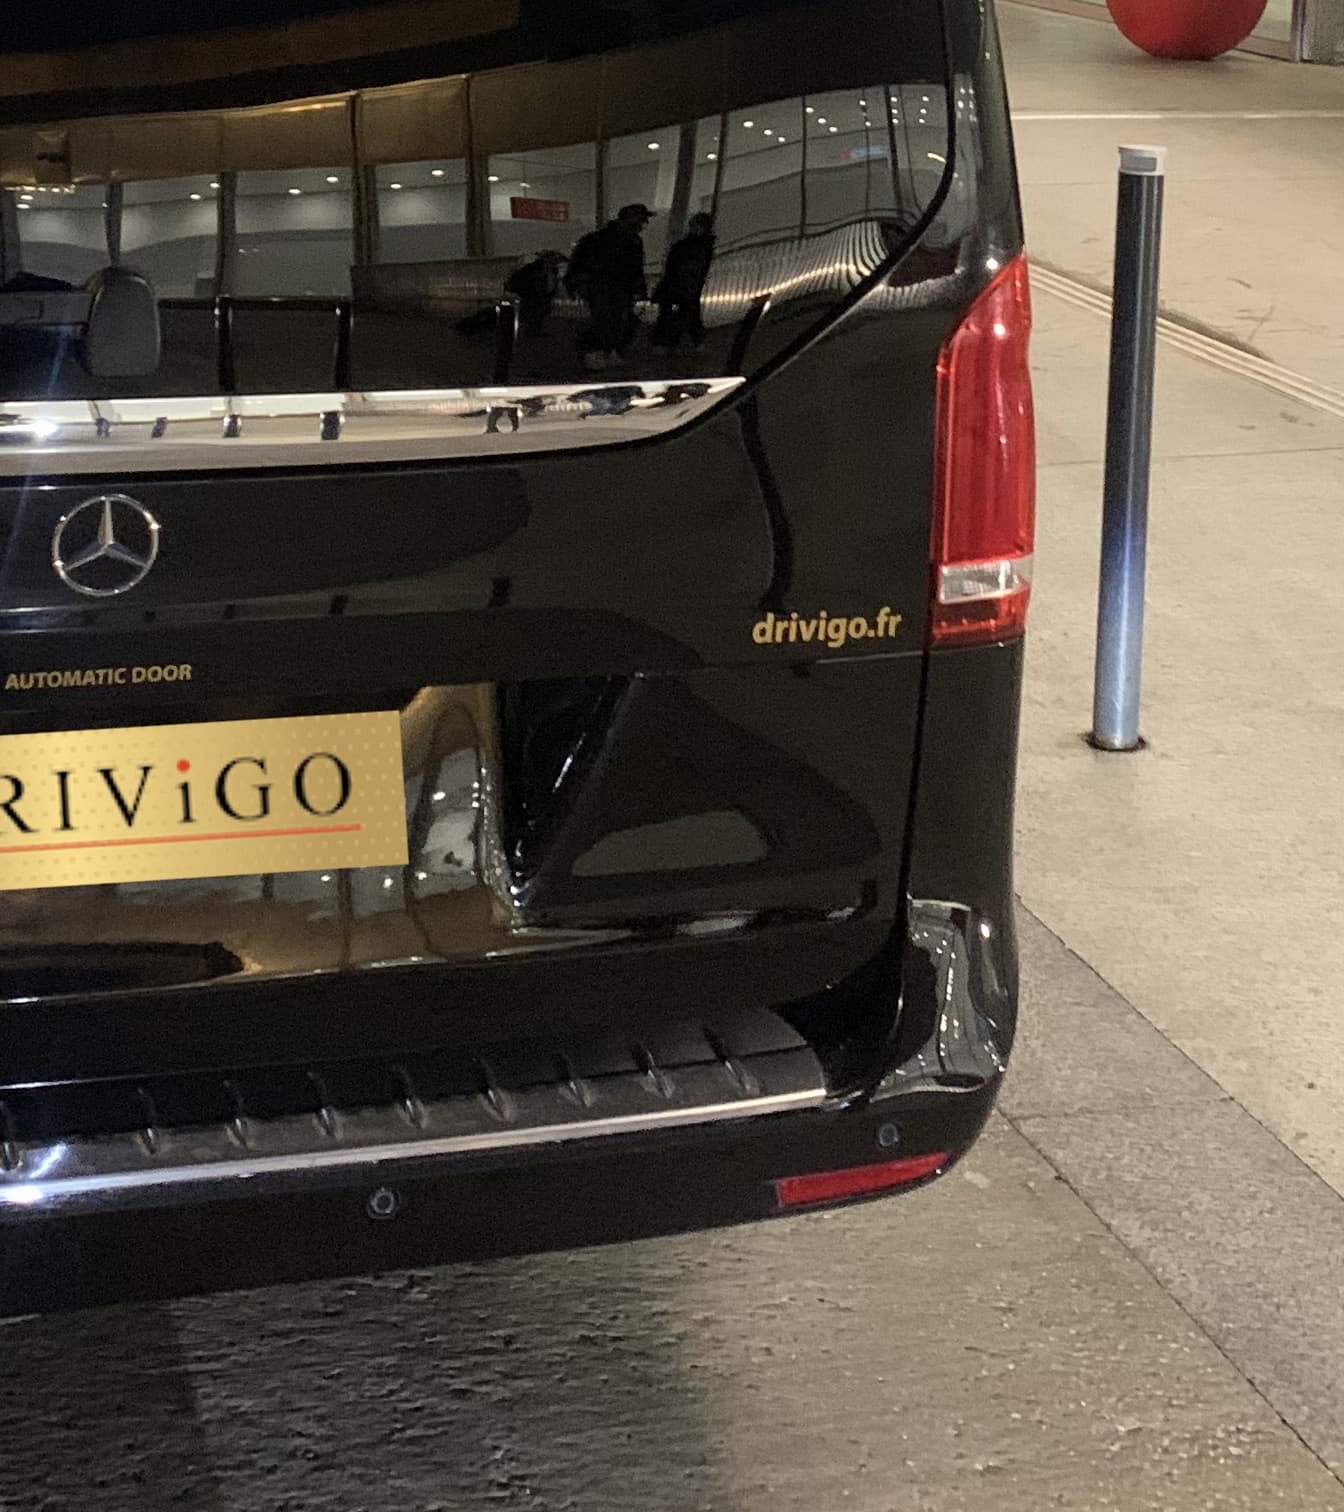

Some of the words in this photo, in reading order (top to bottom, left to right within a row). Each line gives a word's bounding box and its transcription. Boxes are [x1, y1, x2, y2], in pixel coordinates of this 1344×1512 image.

[751, 605, 903, 648] drivigo.fr
[4, 667, 128, 691] AUTOMATIC
[131, 663, 193, 684] DOOR
